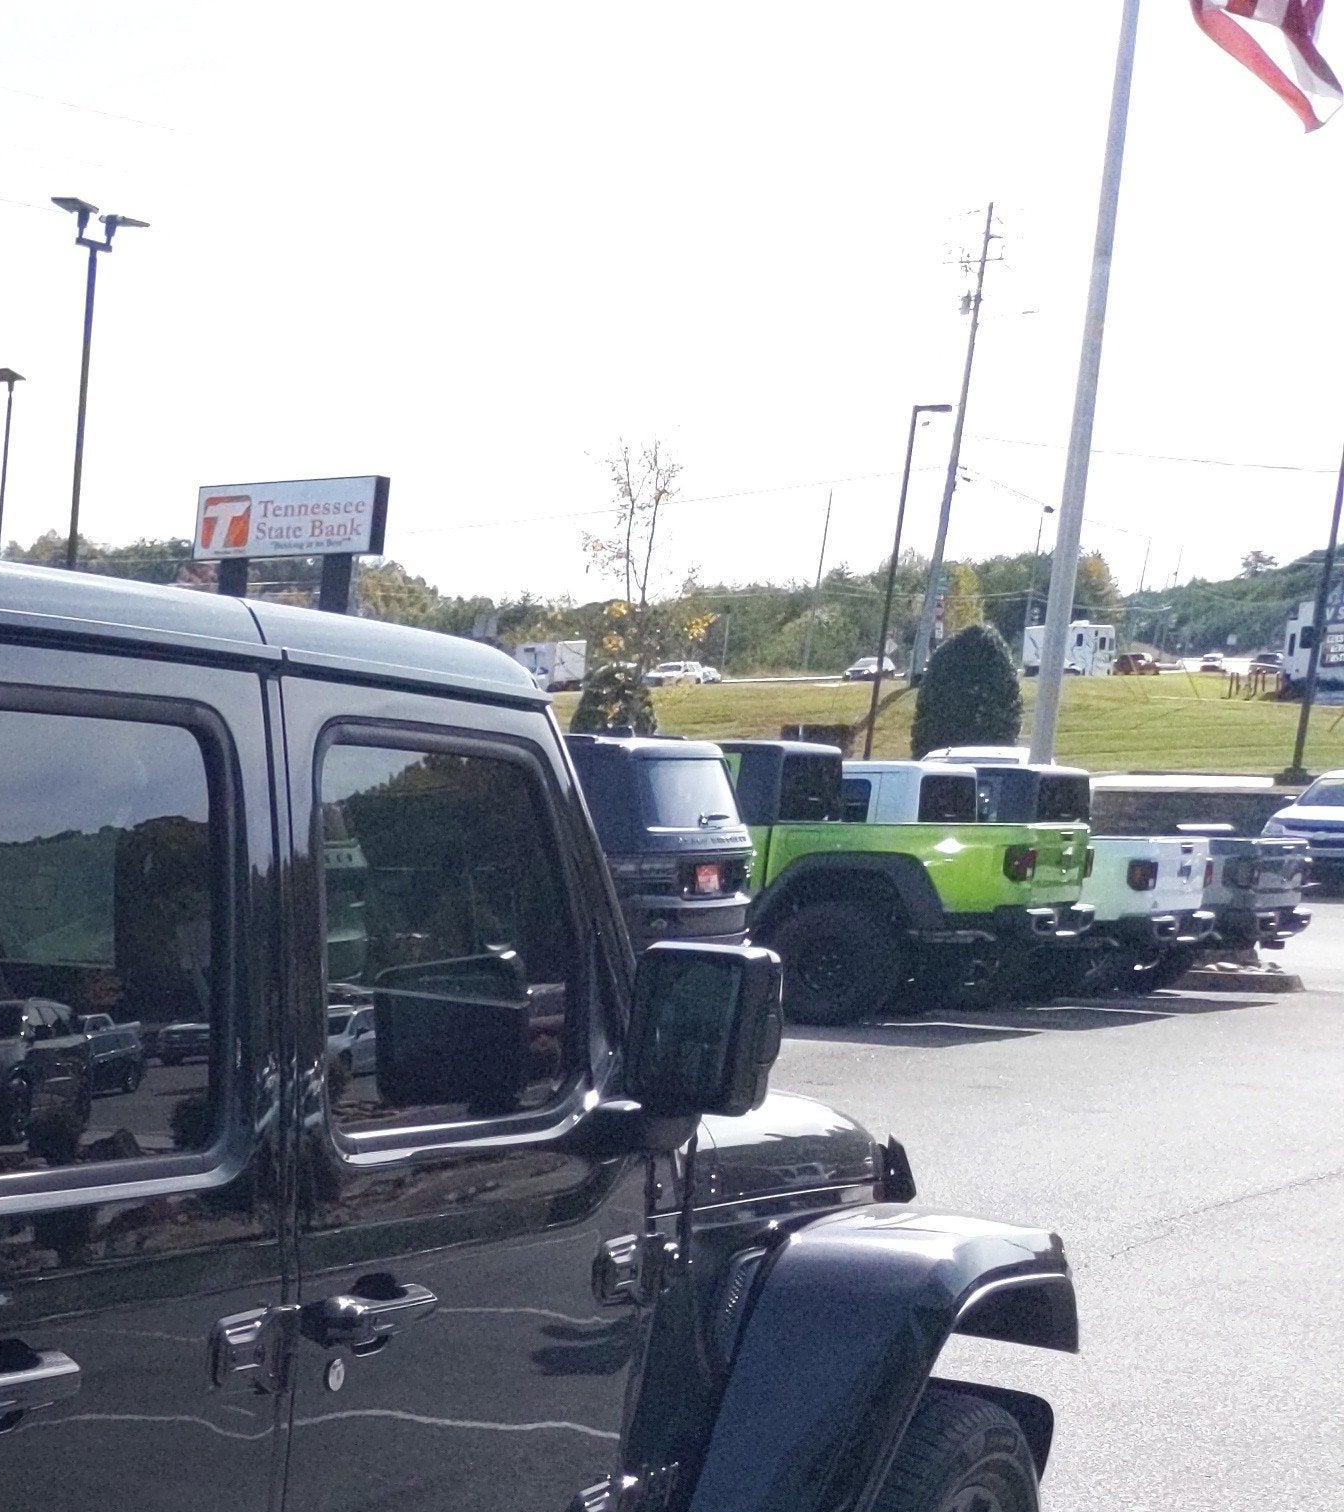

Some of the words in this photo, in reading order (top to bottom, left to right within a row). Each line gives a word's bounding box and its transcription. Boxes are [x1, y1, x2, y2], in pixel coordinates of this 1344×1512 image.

[258, 499, 366, 519] Tennessee
[255, 521, 303, 541] State
[309, 517, 362, 538] Bank
